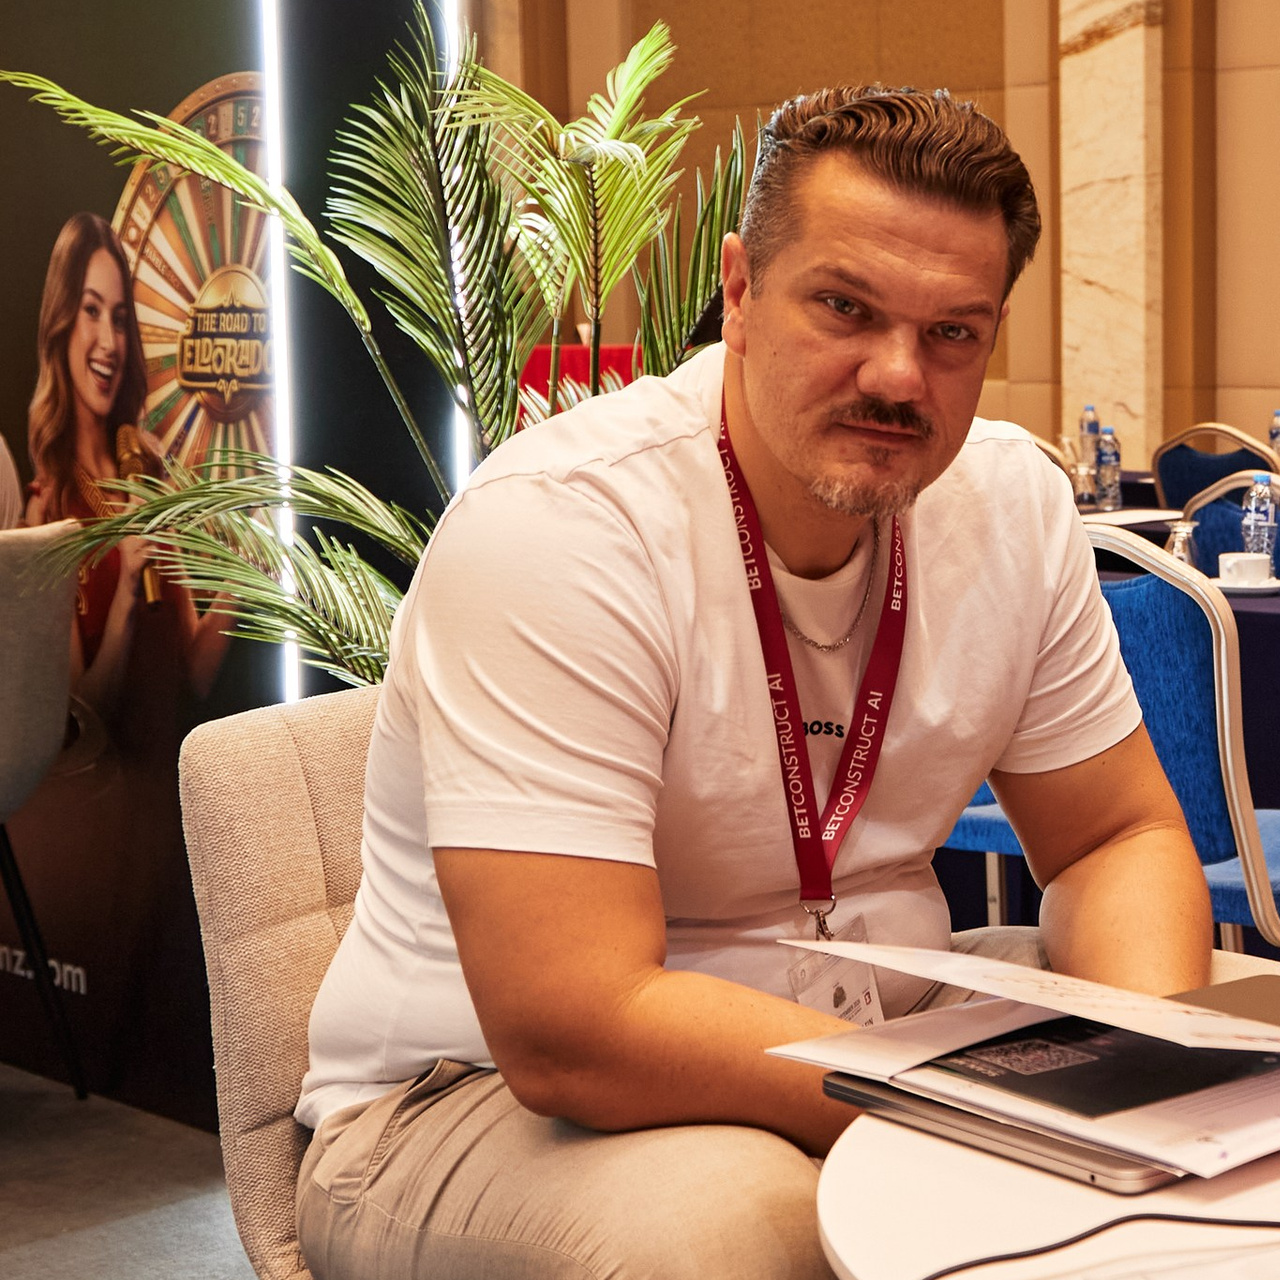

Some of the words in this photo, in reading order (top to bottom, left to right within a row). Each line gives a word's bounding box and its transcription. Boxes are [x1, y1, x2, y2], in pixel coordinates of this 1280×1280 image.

[196, 313, 217, 332] THE
[219, 313, 249, 333] ROAD
[252, 313, 267, 333] TO
[767, 673, 784, 691] AI
[773, 699, 811, 839] BETCONSTRUCT
[822, 713, 878, 841] BETCONSTRUCT
[868, 690, 883, 710] AI
